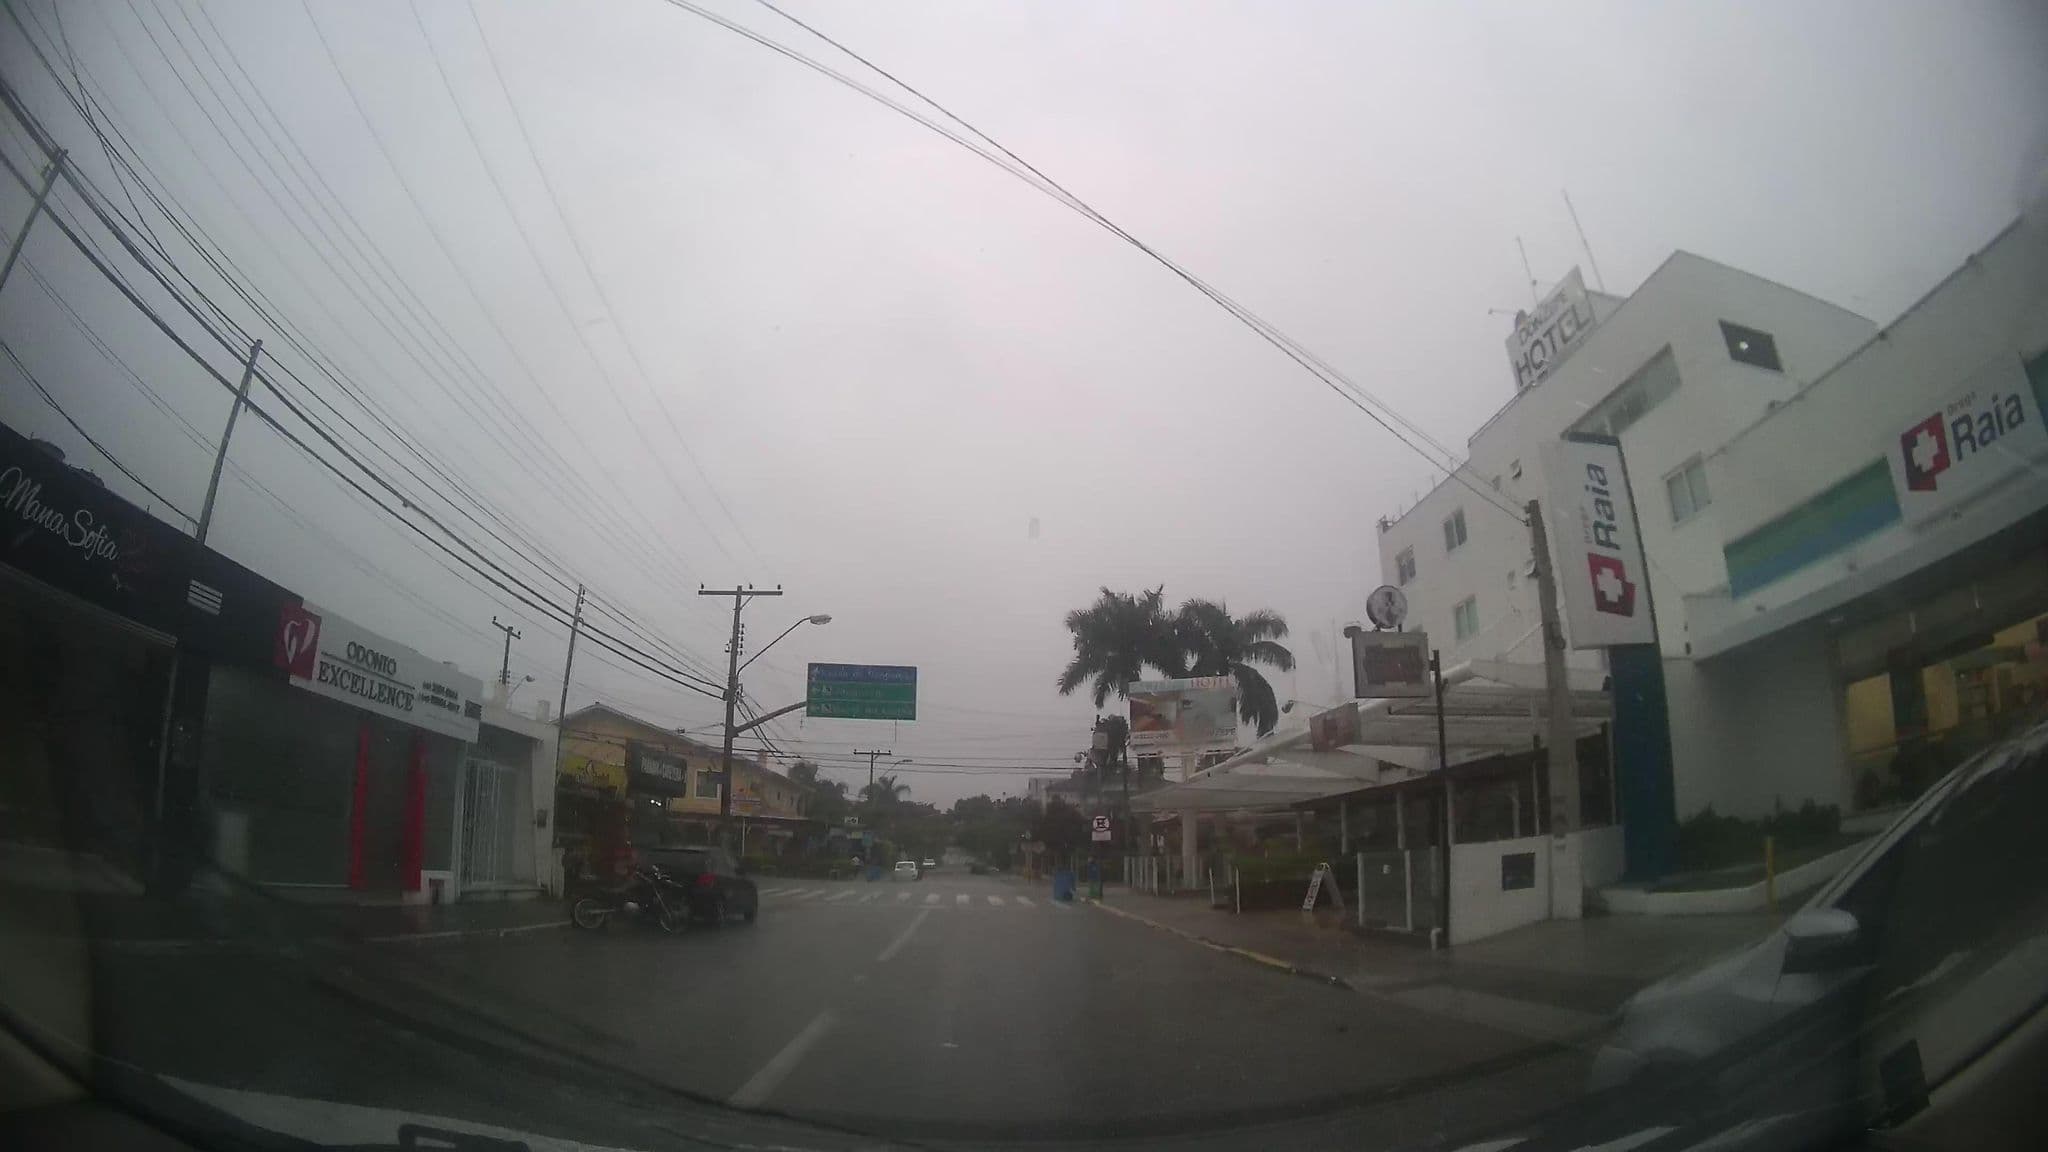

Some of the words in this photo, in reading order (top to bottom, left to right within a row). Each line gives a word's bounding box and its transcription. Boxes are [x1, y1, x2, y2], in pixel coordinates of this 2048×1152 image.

[1515, 303, 1591, 387] HOTEL
[1950, 392, 2025, 462] Raia
[63, 508, 120, 561] Sofia
[1586, 462, 1621, 550] Raia
[317, 661, 415, 712] EXCELLENCE
